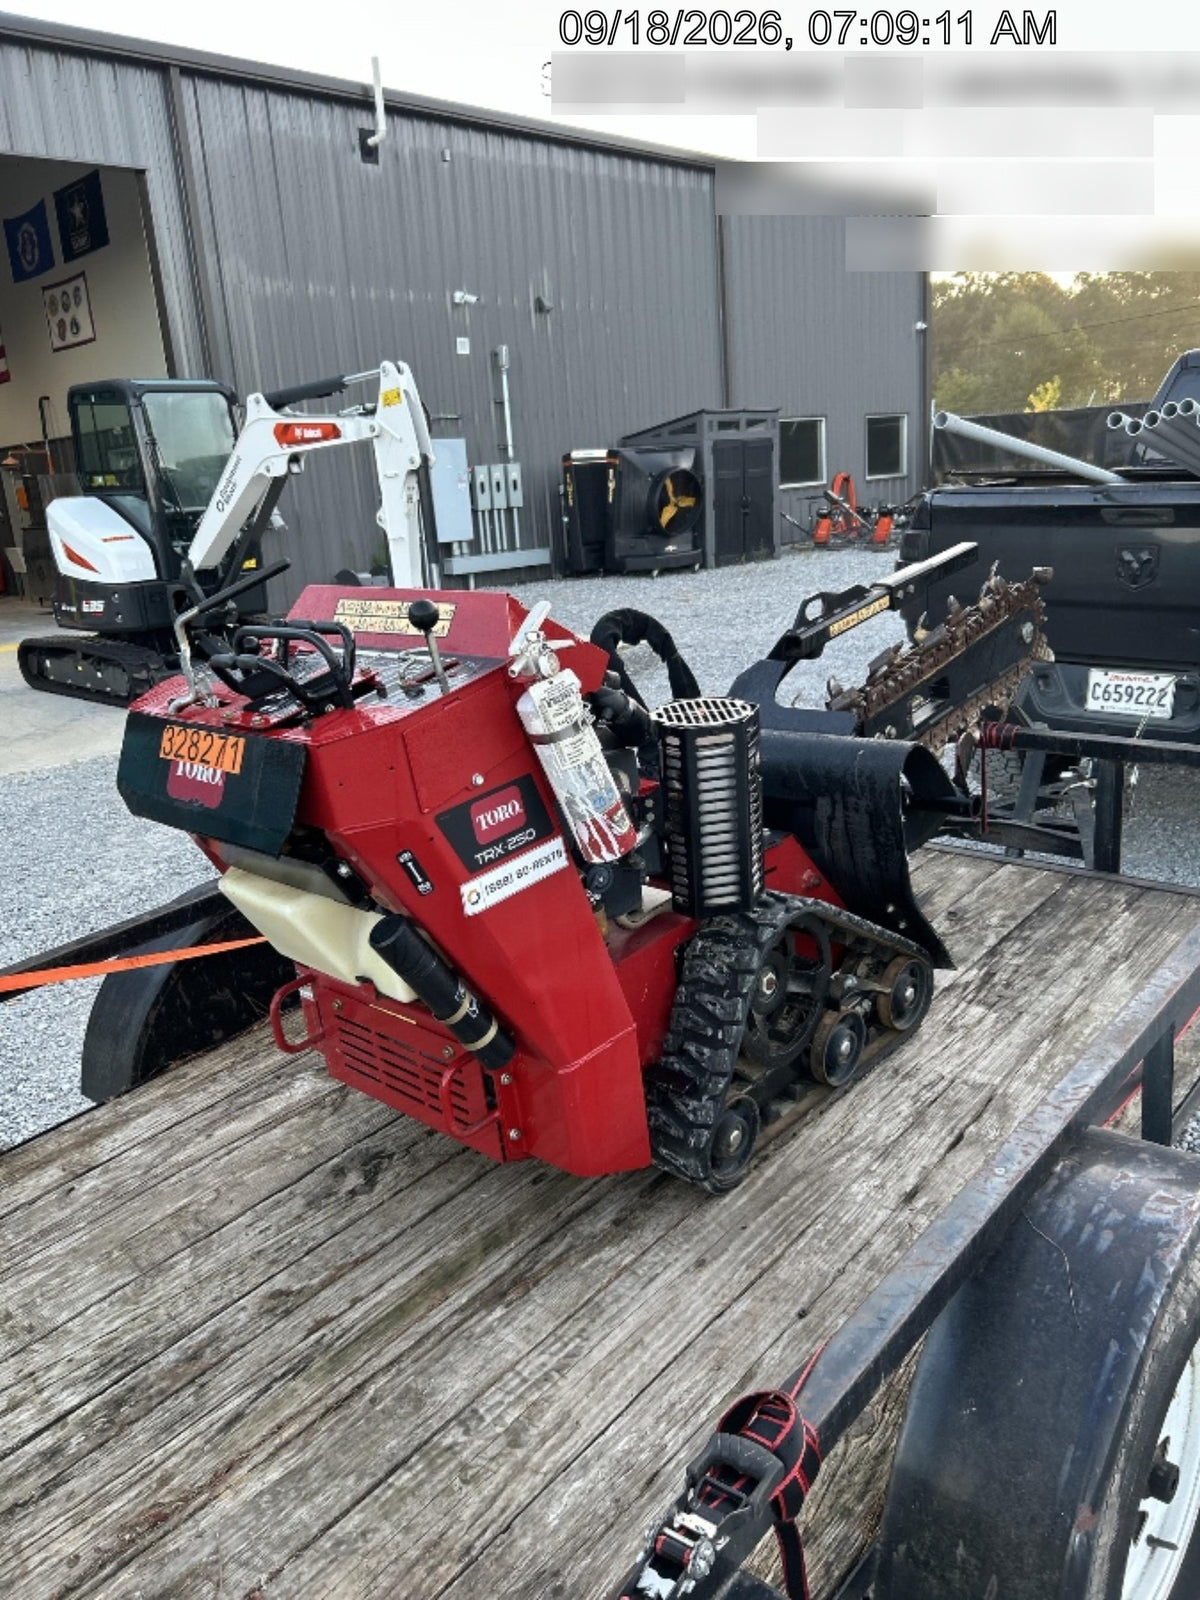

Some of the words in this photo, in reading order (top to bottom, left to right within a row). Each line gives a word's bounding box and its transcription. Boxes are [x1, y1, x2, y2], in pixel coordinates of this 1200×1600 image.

[1091, 682, 1168, 707] C659222
[163, 726, 240, 770] 328271
[475, 799, 523, 830] TORO
[474, 828, 536, 865] TRX-250
